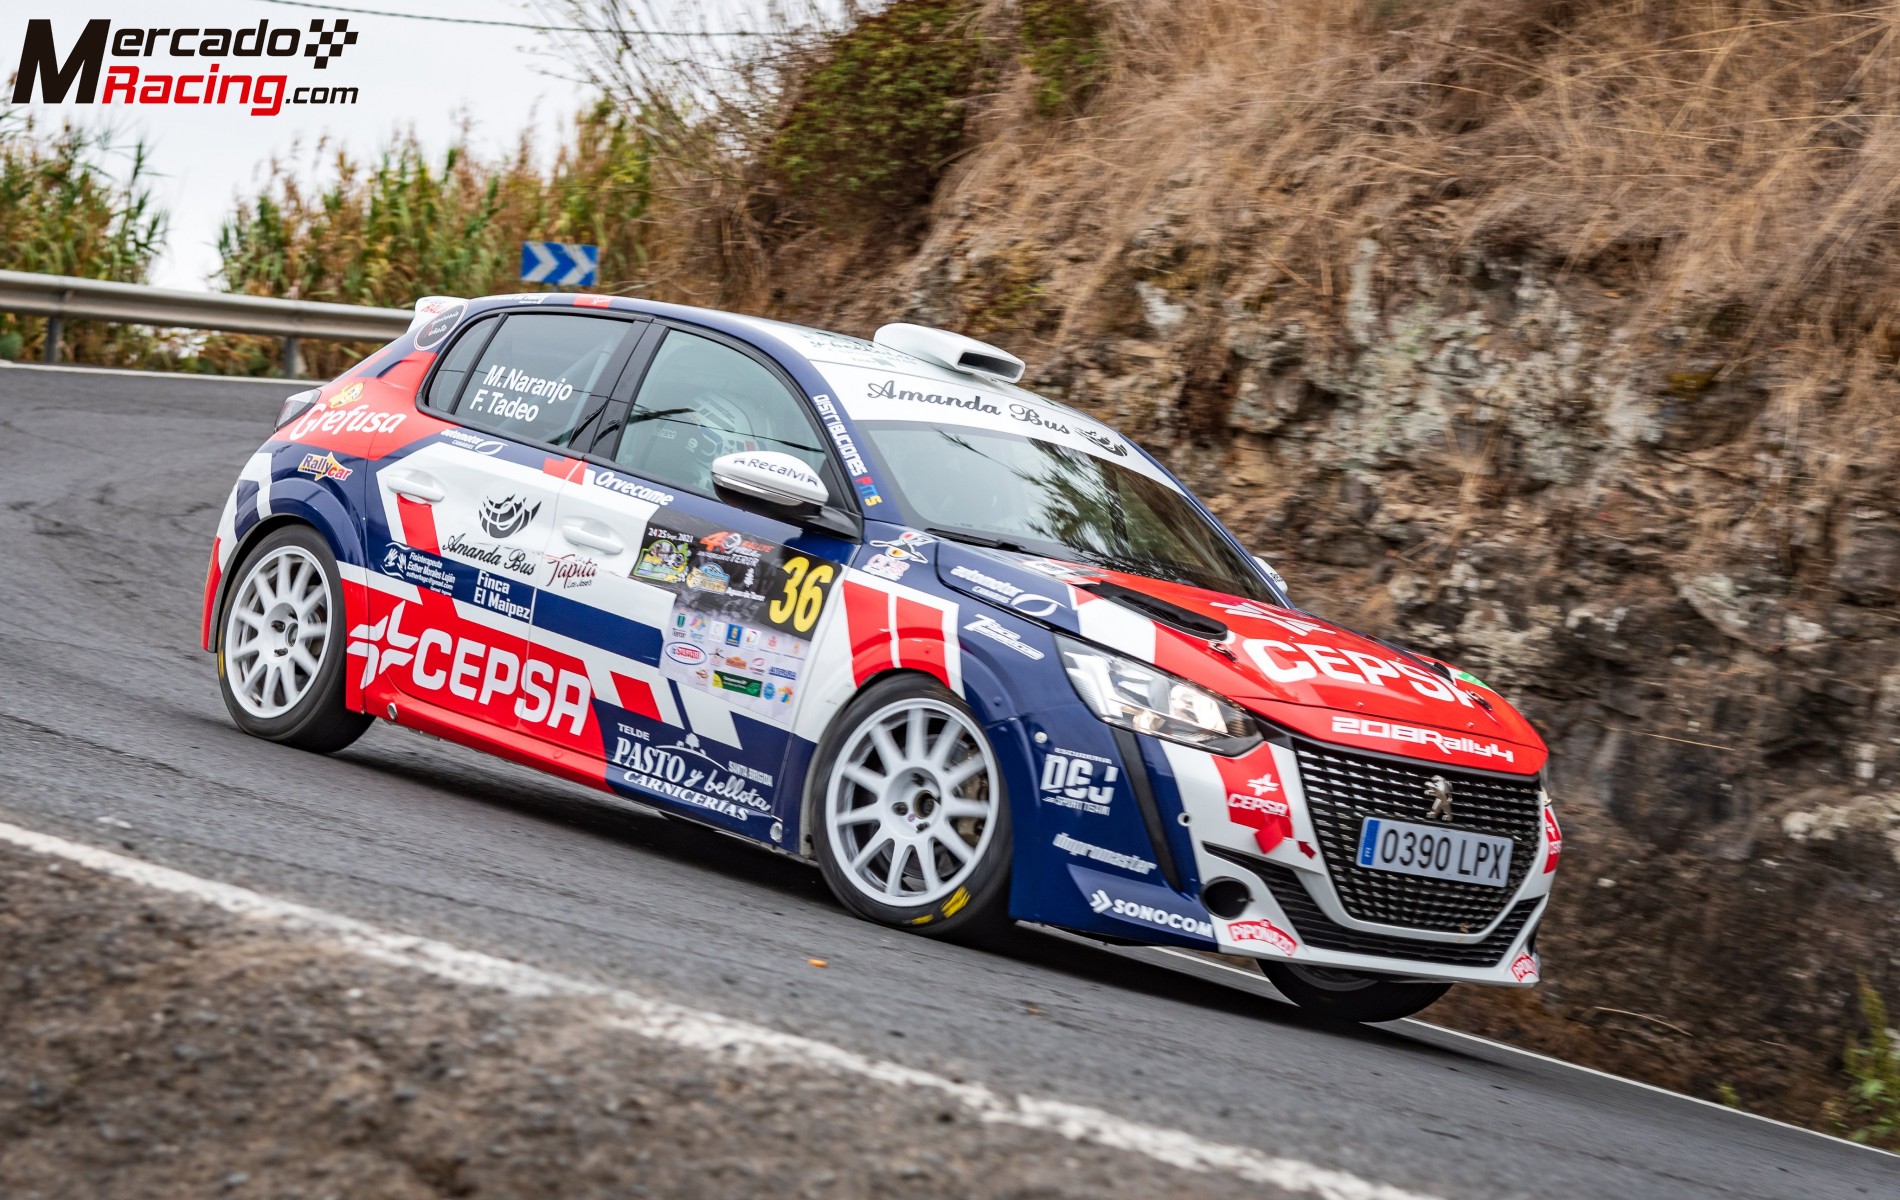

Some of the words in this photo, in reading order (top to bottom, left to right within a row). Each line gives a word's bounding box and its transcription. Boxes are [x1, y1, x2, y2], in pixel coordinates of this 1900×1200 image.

[289, 403, 408, 441] Grefusa
[486, 391, 539, 423] Tadeo
[867, 379, 1002, 416] Amanda
[1009, 403, 1071, 435] Bus
[595, 471, 675, 506] Orvecame
[748, 457, 807, 482] Recalvi
[442, 533, 502, 565] Amanda
[504, 548, 536, 576] Bus
[477, 569, 510, 594] Finca
[769, 556, 834, 633] 36
[473, 587, 487, 605] El
[487, 591, 531, 620] Maipez
[411, 627, 591, 737] CEPSA
[1242, 637, 1475, 709] CEPSA
[617, 723, 651, 741] TELDE
[611, 737, 686, 784] PASTO
[684, 768, 705, 788] y
[704, 769, 772, 812] bellota
[1228, 792, 1289, 817] CEPSA
[1381, 828, 1452, 872] 0390
[1458, 839, 1506, 880] LPX
[1112, 899, 1213, 939] SONOCOM
